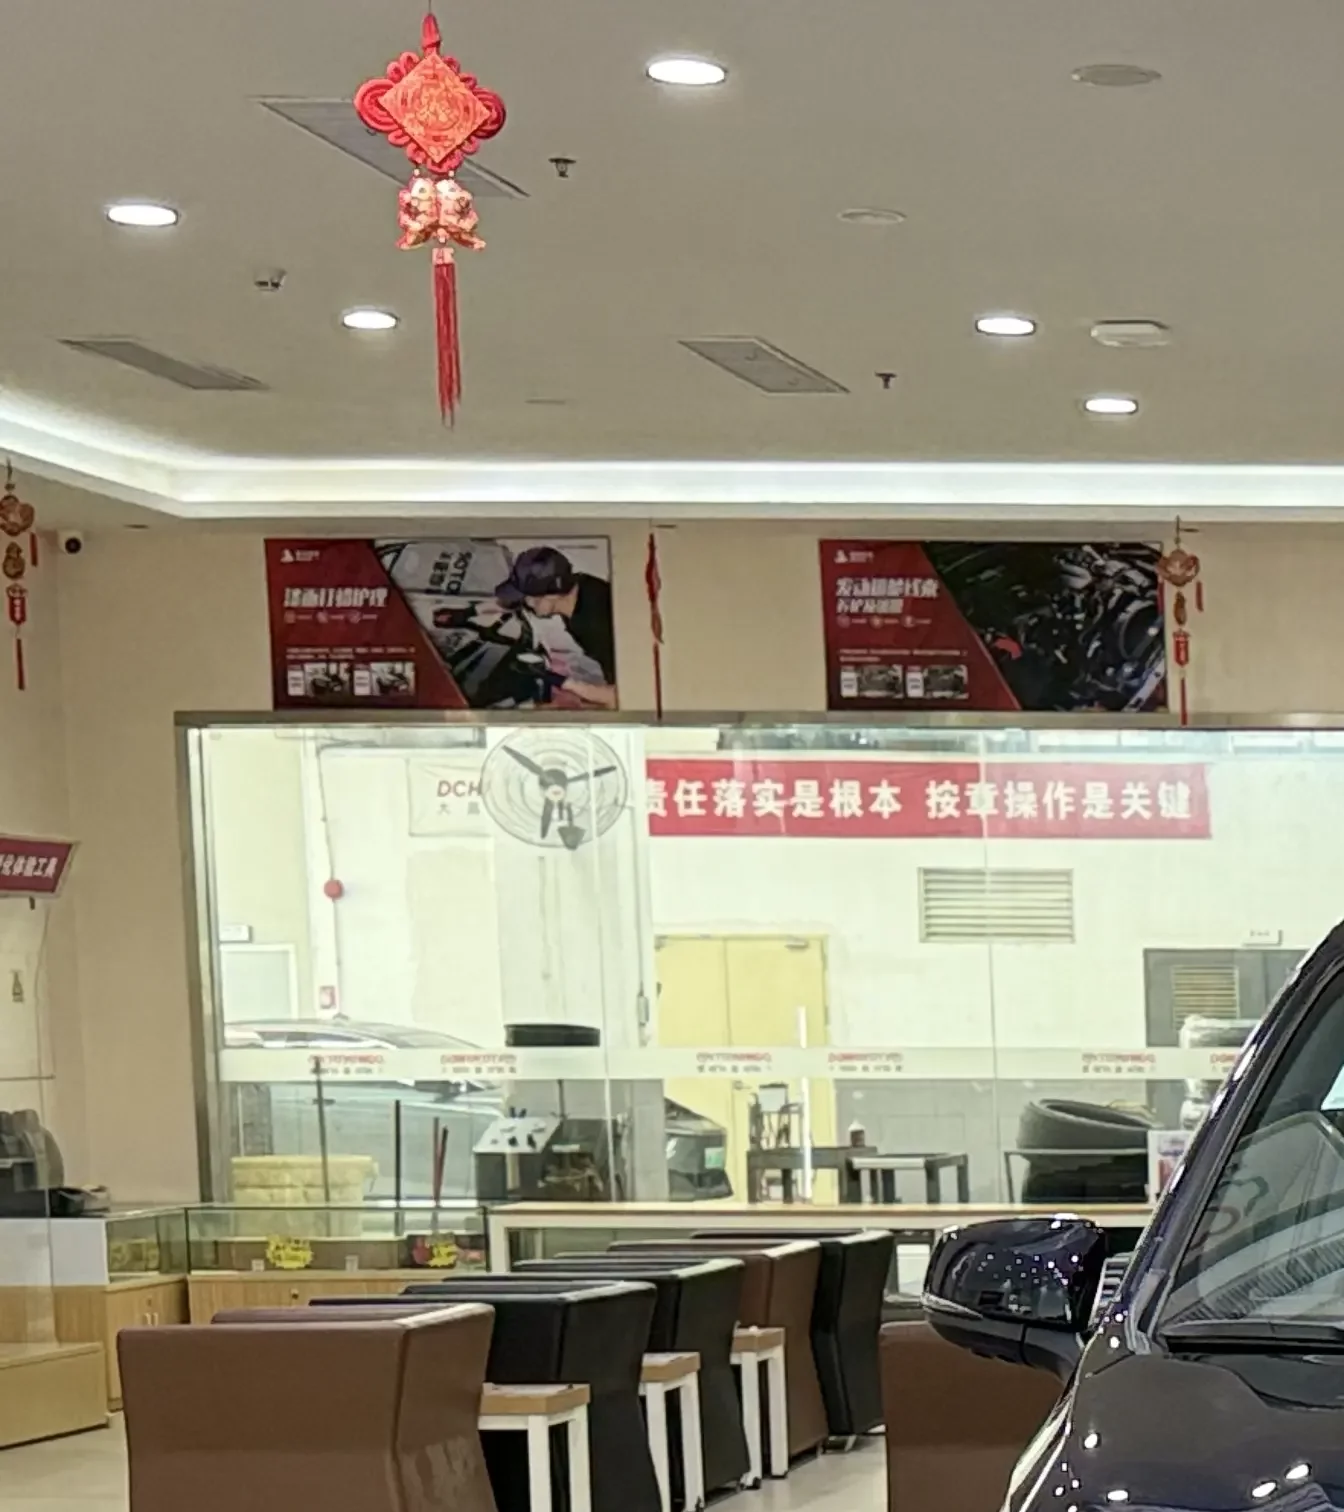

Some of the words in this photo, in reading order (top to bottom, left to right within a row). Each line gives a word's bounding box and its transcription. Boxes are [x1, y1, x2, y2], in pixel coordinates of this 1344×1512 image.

[925, 780, 1193, 821] 按章操作是关键
